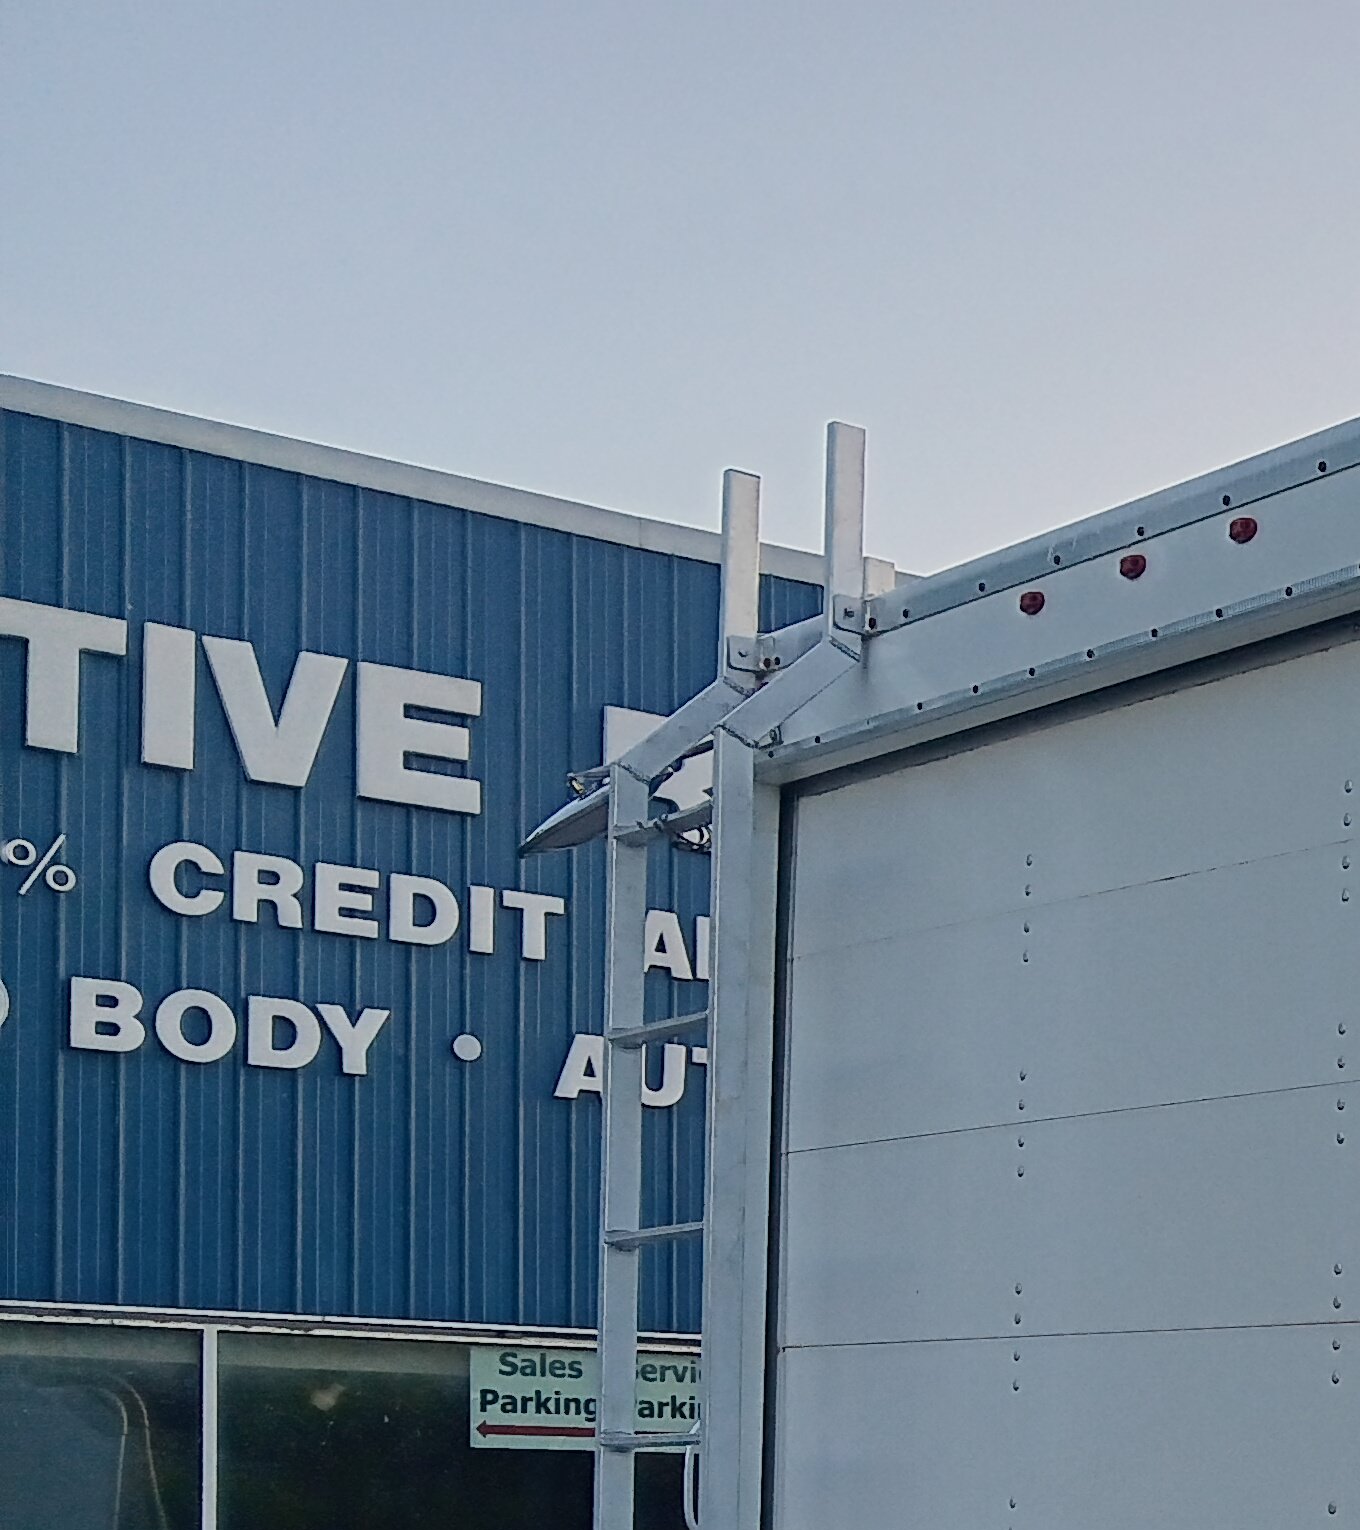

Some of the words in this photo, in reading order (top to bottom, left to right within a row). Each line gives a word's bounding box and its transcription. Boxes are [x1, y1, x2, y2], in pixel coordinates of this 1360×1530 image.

[149, 841, 565, 961] CREDIT
[70, 976, 390, 1075] BODY
[498, 1352, 583, 1379] Sales
[636, 1360, 701, 1384] ervi
[479, 1388, 597, 1423] Parking
